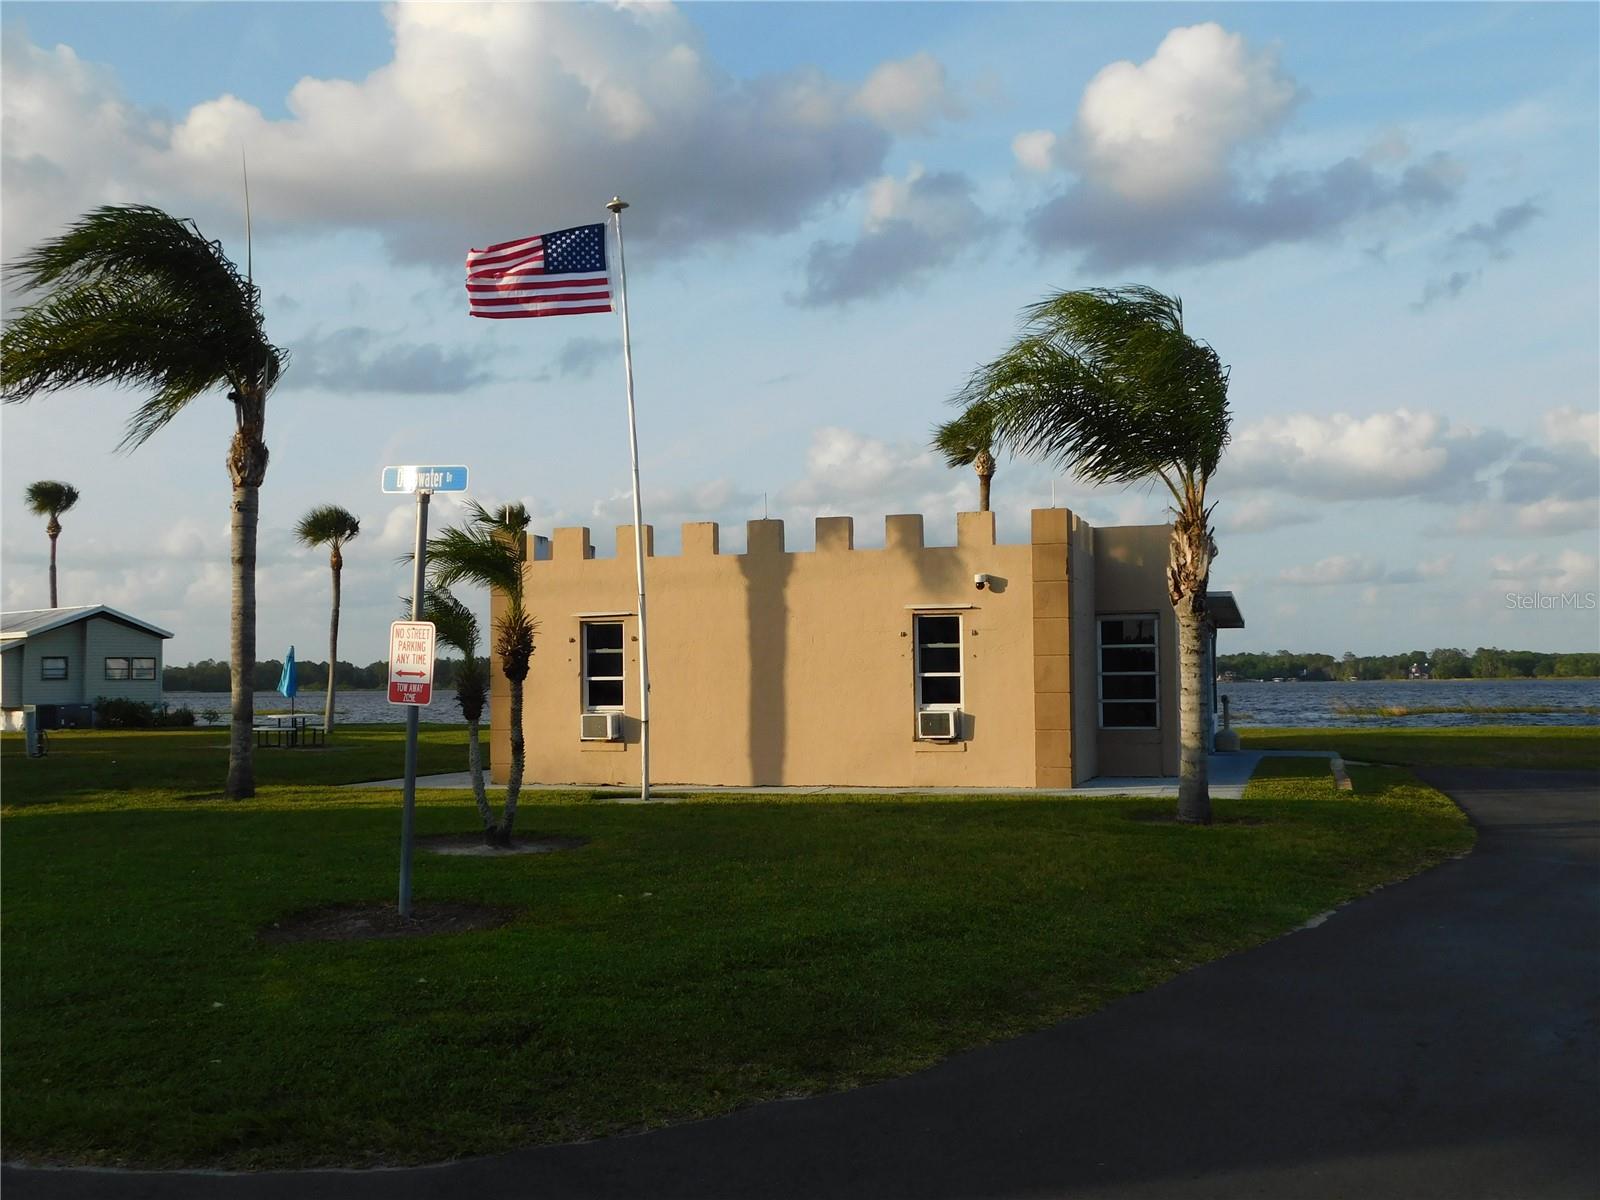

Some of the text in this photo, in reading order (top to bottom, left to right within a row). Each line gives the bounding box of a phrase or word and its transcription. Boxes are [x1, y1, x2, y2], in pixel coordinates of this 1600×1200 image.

[396, 468, 444, 488] Dwater
[395, 628, 430, 640] NO STREET
[398, 640, 426, 652] PARKING
[396, 653, 426, 665] ANY TIME
[397, 682, 424, 693] TOW AWAY
[403, 693, 416, 702] ZONE
